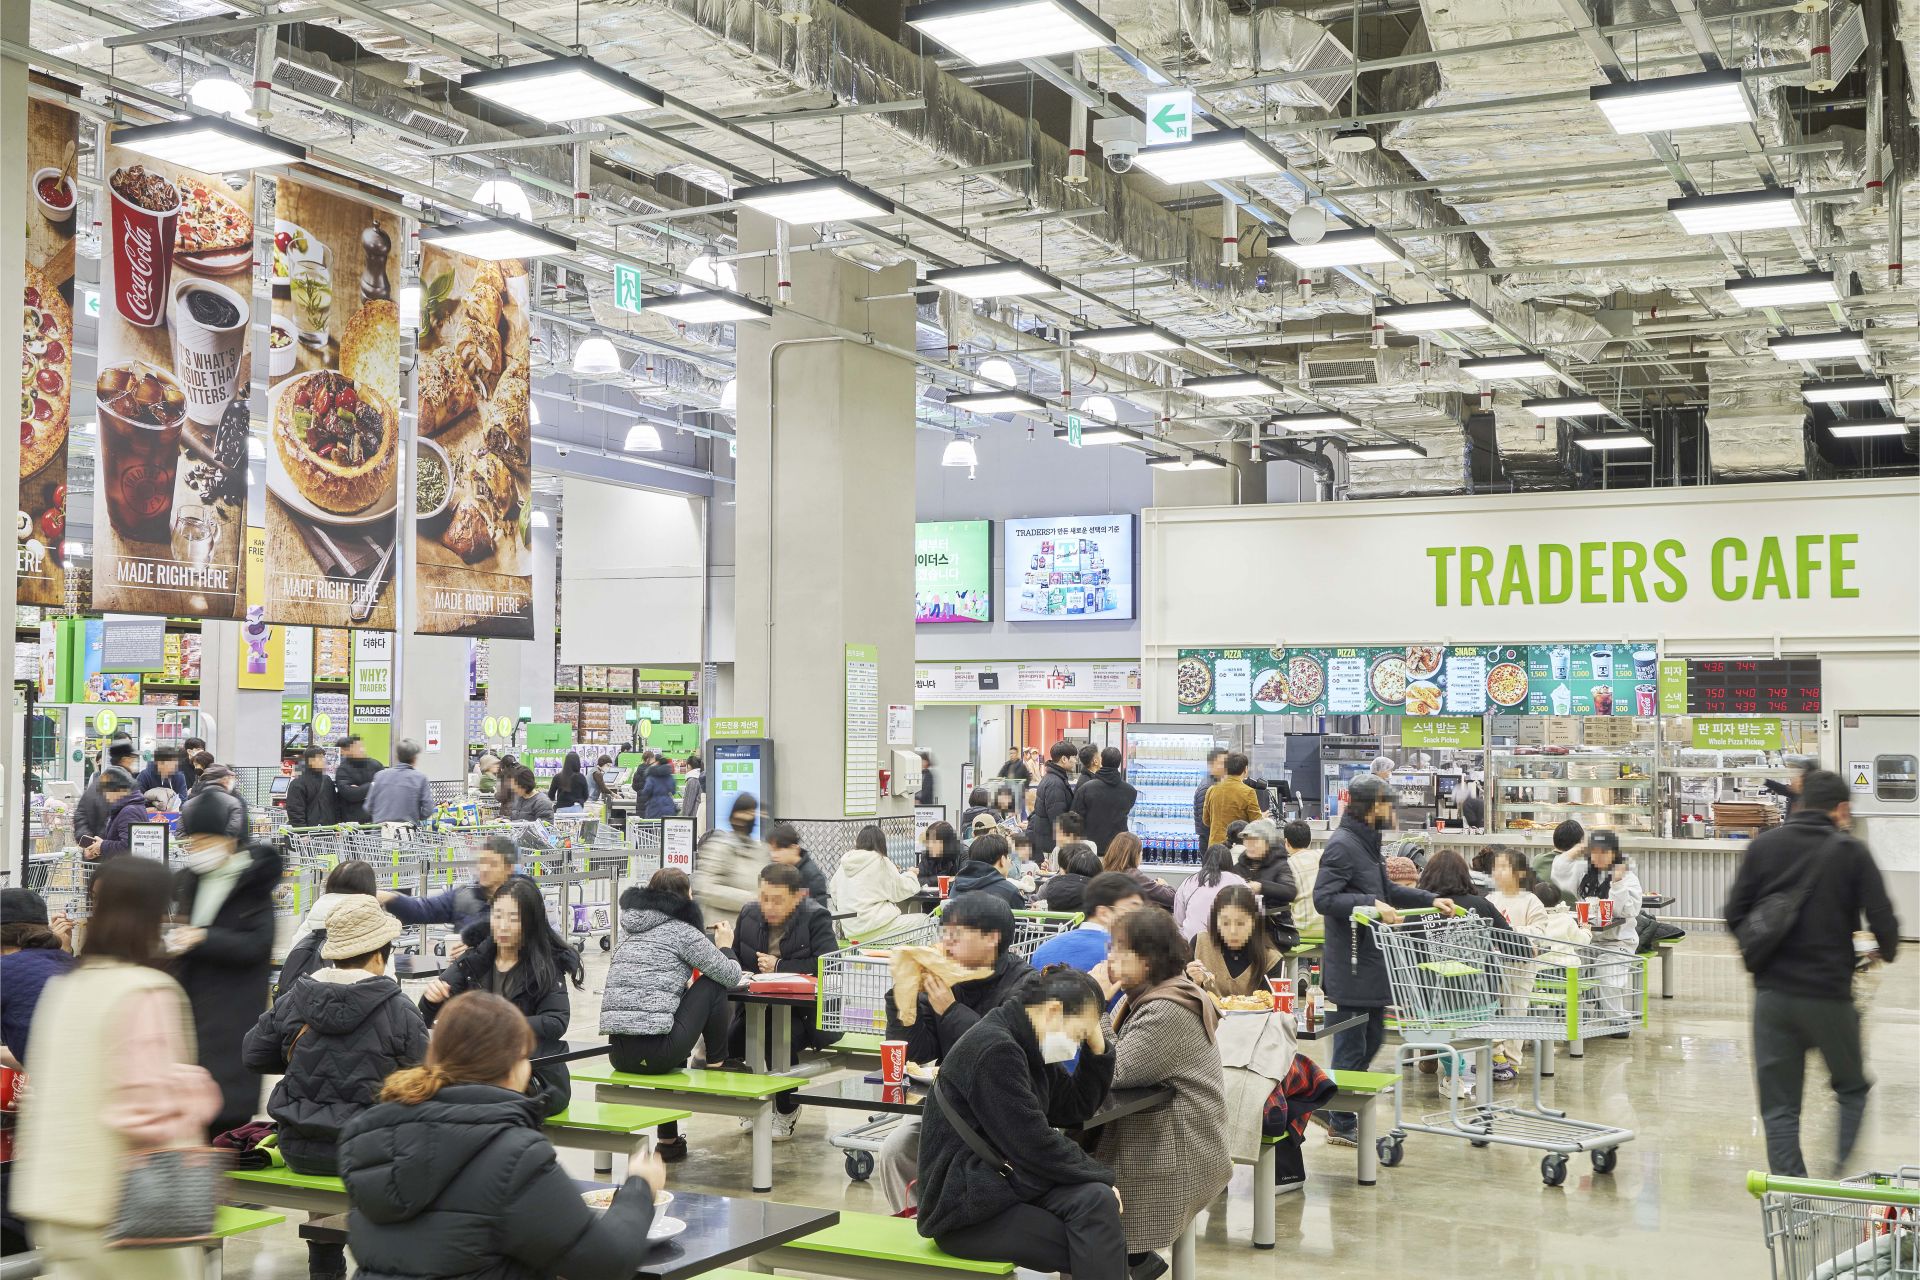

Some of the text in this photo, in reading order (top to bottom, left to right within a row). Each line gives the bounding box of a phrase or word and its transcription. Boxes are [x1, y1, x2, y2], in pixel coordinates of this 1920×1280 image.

[193, 347, 236, 370] WHAT'S
[210, 364, 237, 387] THAT
[1016, 525, 1120, 537] TRADERS가 만든 새로운 선택의 기준
[17, 550, 43, 574] ERE
[915, 553, 959, 567] 이더스가
[1426, 533, 1860, 606] TRADERS CAFE
[117, 561, 229, 590] MADE RIGHT HERE
[283, 578, 379, 603] MADE RIGHT HERE
[435, 592, 520, 614] MADE RIGHT HERE
[363, 638, 386, 648] 더하다
[1224, 650, 1241, 658] PIZZA
[1337, 649, 1356, 657] PIZZA
[1455, 647, 1477, 657] SNACK
[1664, 667, 1683, 676] 피자
[1704, 662, 1756, 672] 436 744
[360, 669, 388, 682] WHY?
[360, 684, 387, 692] TRADERS
[1706, 688, 1819, 698] 750 440 749 748
[1664, 693, 1682, 703] 스낵
[293, 704, 307, 720] 21
[355, 706, 390, 715] TRADERS
[1530, 705, 1548, 713] 2,500
[1573, 705, 1590, 713] 1,000
[1706, 702, 1819, 711] 747 439 746 129
[103, 715, 111, 730] 5
[319, 718, 327, 731] 4
[503, 720, 509, 732] 2
[714, 720, 759, 730] 카드전용 계산대
[1413, 722, 1470, 734] 스낵 받는 곳
[1698, 723, 1775, 735] 판 피자 받는 곳
[1441, 736, 1460, 745] Pickup
[1744, 738, 1766, 746] Pickup
[668, 854, 689, 865] 9,800
